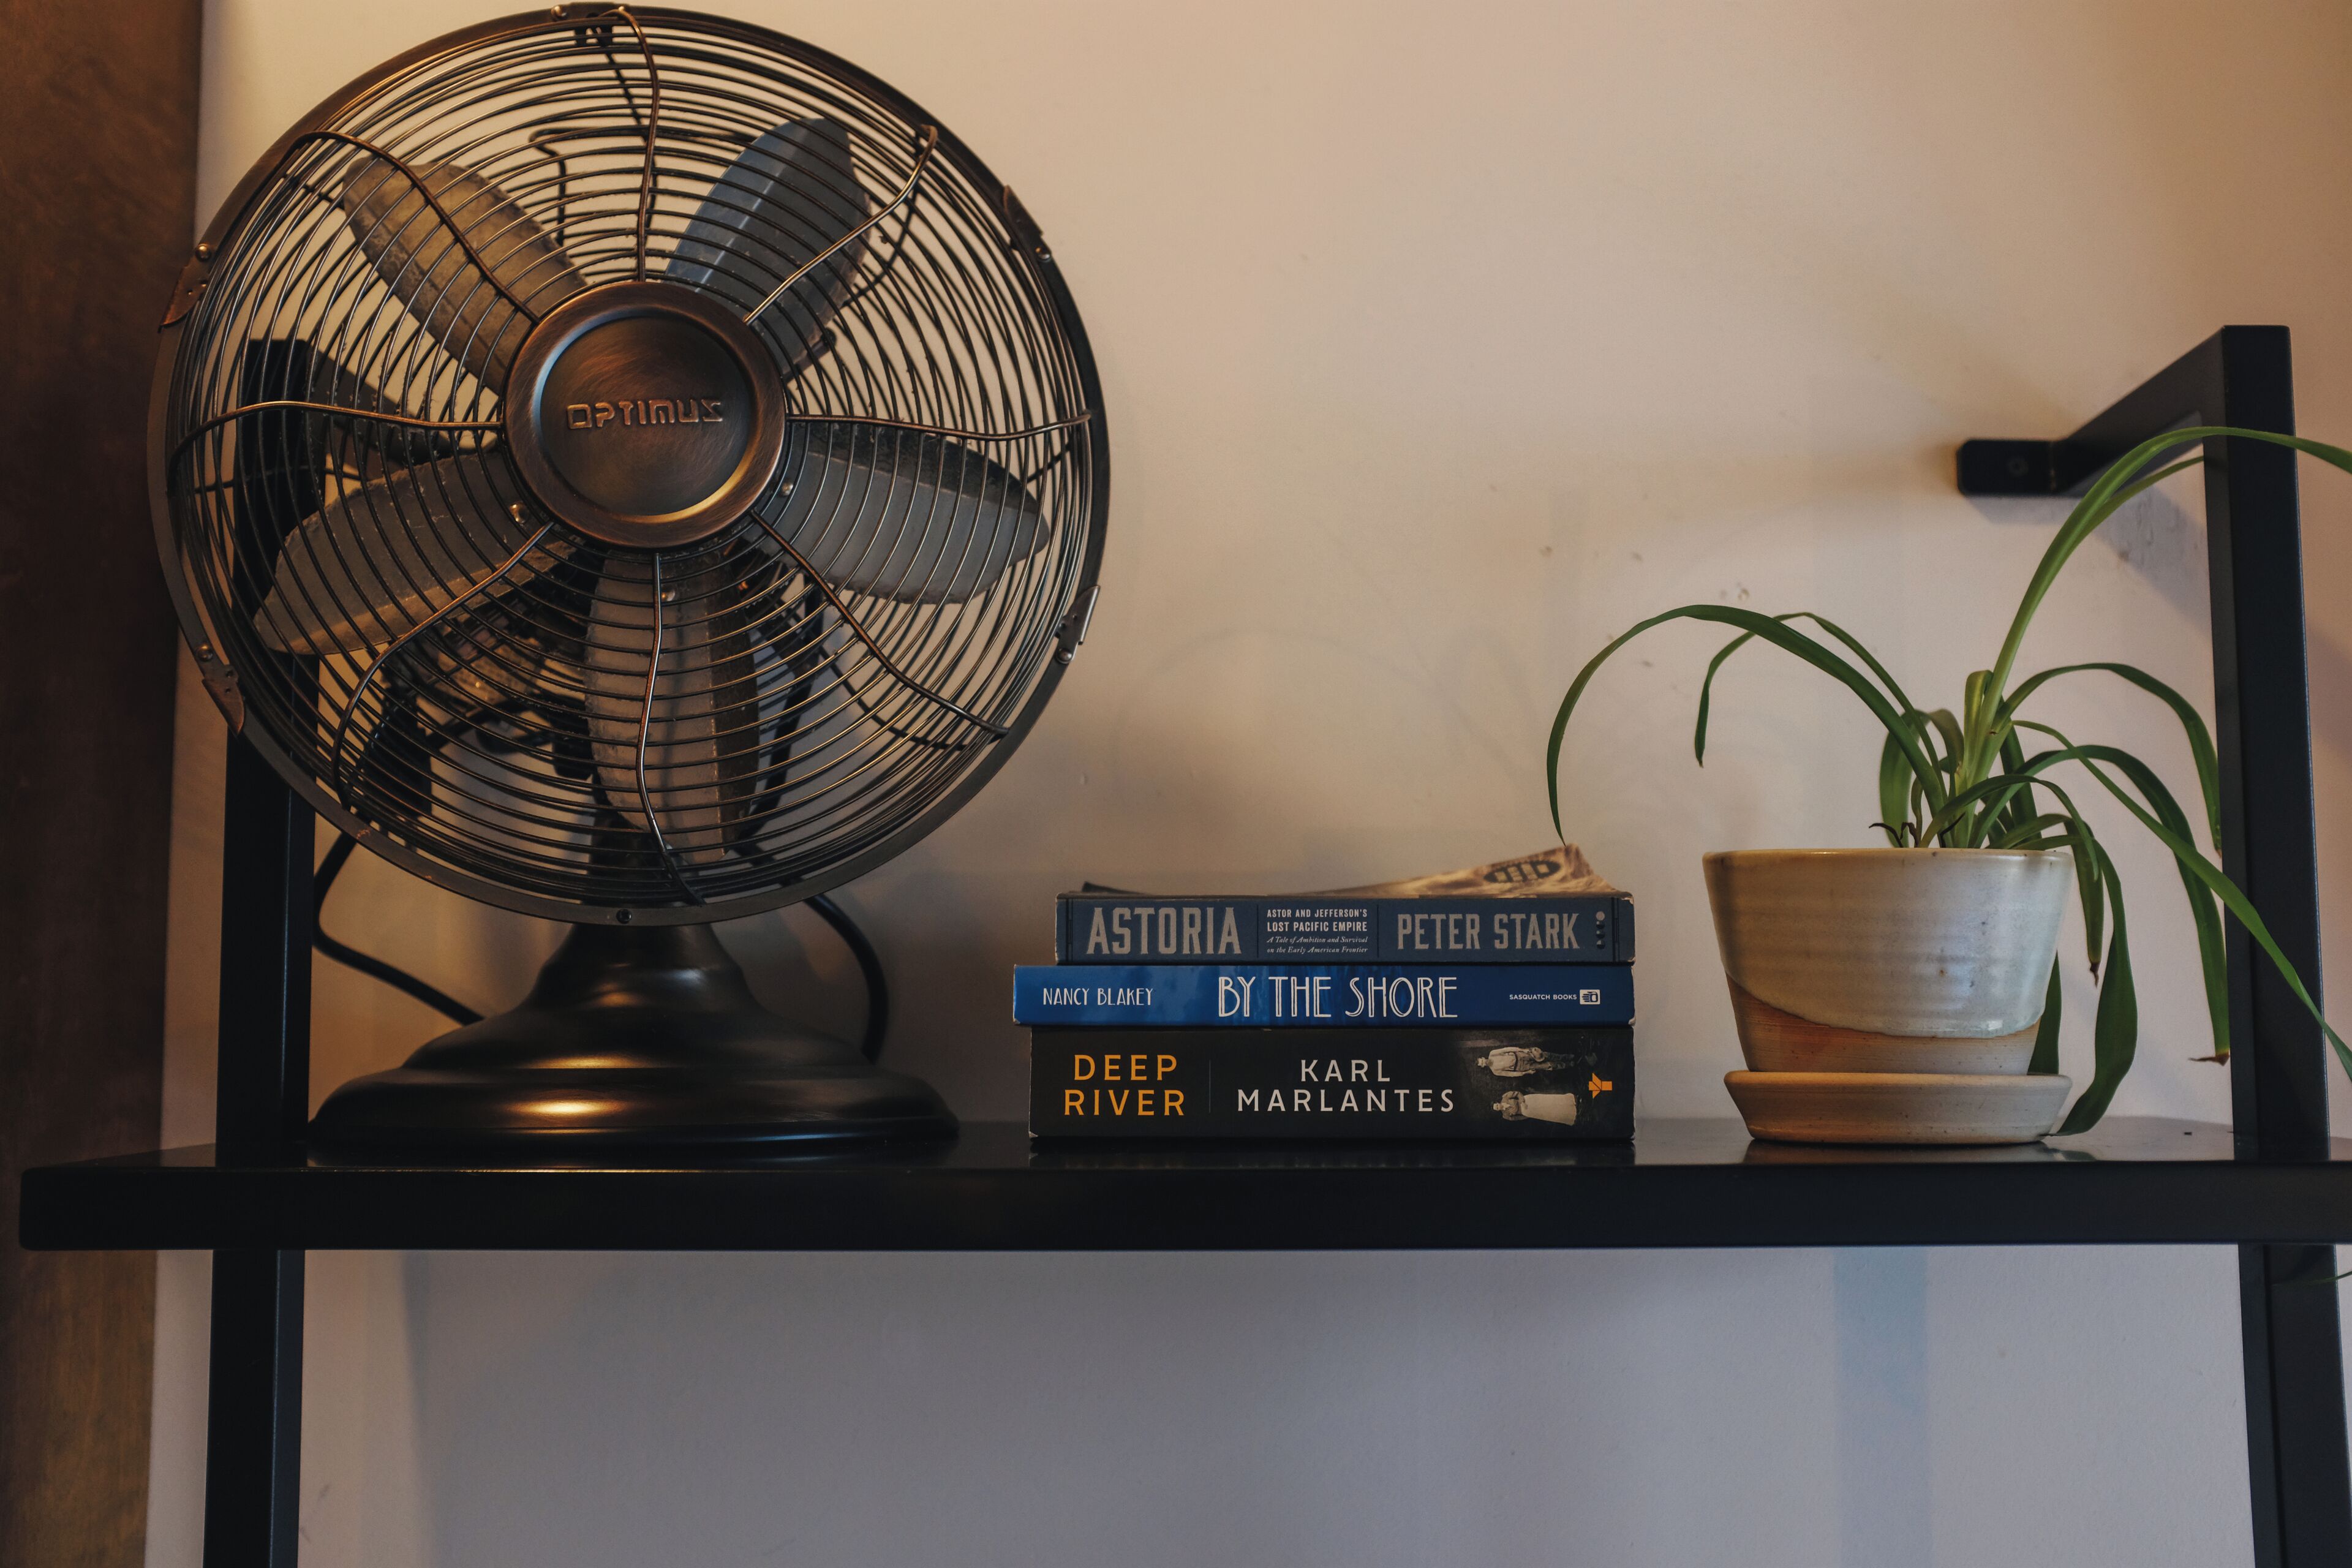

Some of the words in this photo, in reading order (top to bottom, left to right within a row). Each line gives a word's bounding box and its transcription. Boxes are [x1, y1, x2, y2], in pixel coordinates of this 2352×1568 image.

[566, 399, 723, 430] OPTIMUS
[1267, 909, 1292, 918] ASTOR
[1295, 909, 1311, 918] AND
[1314, 909, 1367, 918] JEFFERSON'S
[1086, 907, 1242, 955] ASTORIA
[1267, 922, 1289, 932] LOST
[1293, 921, 1329, 932] PACIFIC
[1333, 921, 1368, 932] EMPIRE
[1398, 914, 1480, 950] PETER
[1494, 913, 1580, 949] STARK
[1287, 946, 1306, 955] Early
[1043, 987, 1090, 1006] NANCY
[1097, 987, 1153, 1006] BLAKEY
[1218, 976, 1256, 1017] BY
[1268, 976, 1332, 1017] THE
[1345, 977, 1458, 1018] SHORE
[1074, 1054, 1177, 1080] DEEP
[1301, 1059, 1390, 1082] KARL
[1064, 1089, 1185, 1116] RIVER
[1237, 1089, 1453, 1112] MARLANTES
